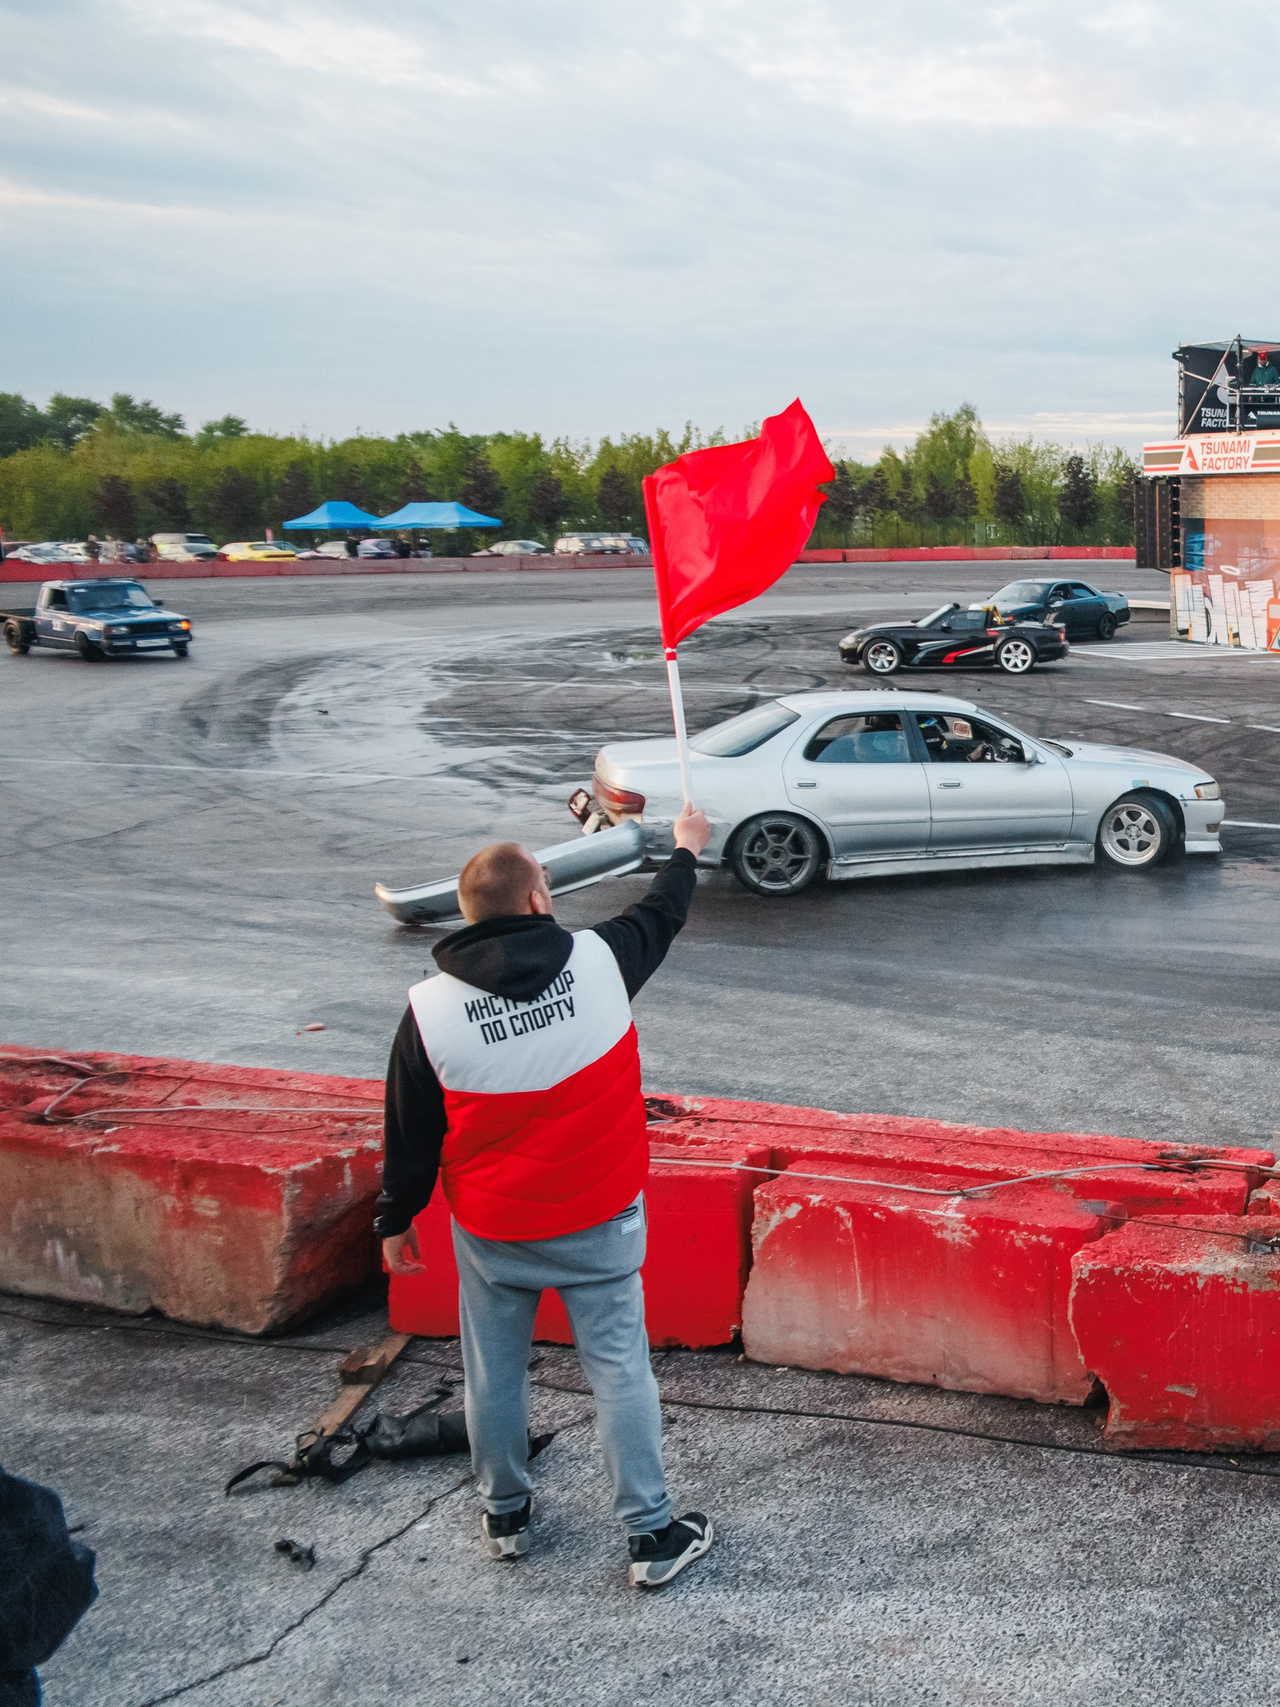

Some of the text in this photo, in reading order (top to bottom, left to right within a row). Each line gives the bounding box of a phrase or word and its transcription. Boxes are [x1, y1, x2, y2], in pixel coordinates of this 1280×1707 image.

[1200, 440, 1251, 455] TSUNAMI
[1201, 456, 1251, 471] FACTORY
[480, 996, 575, 1045] ПО СПОРТУ
